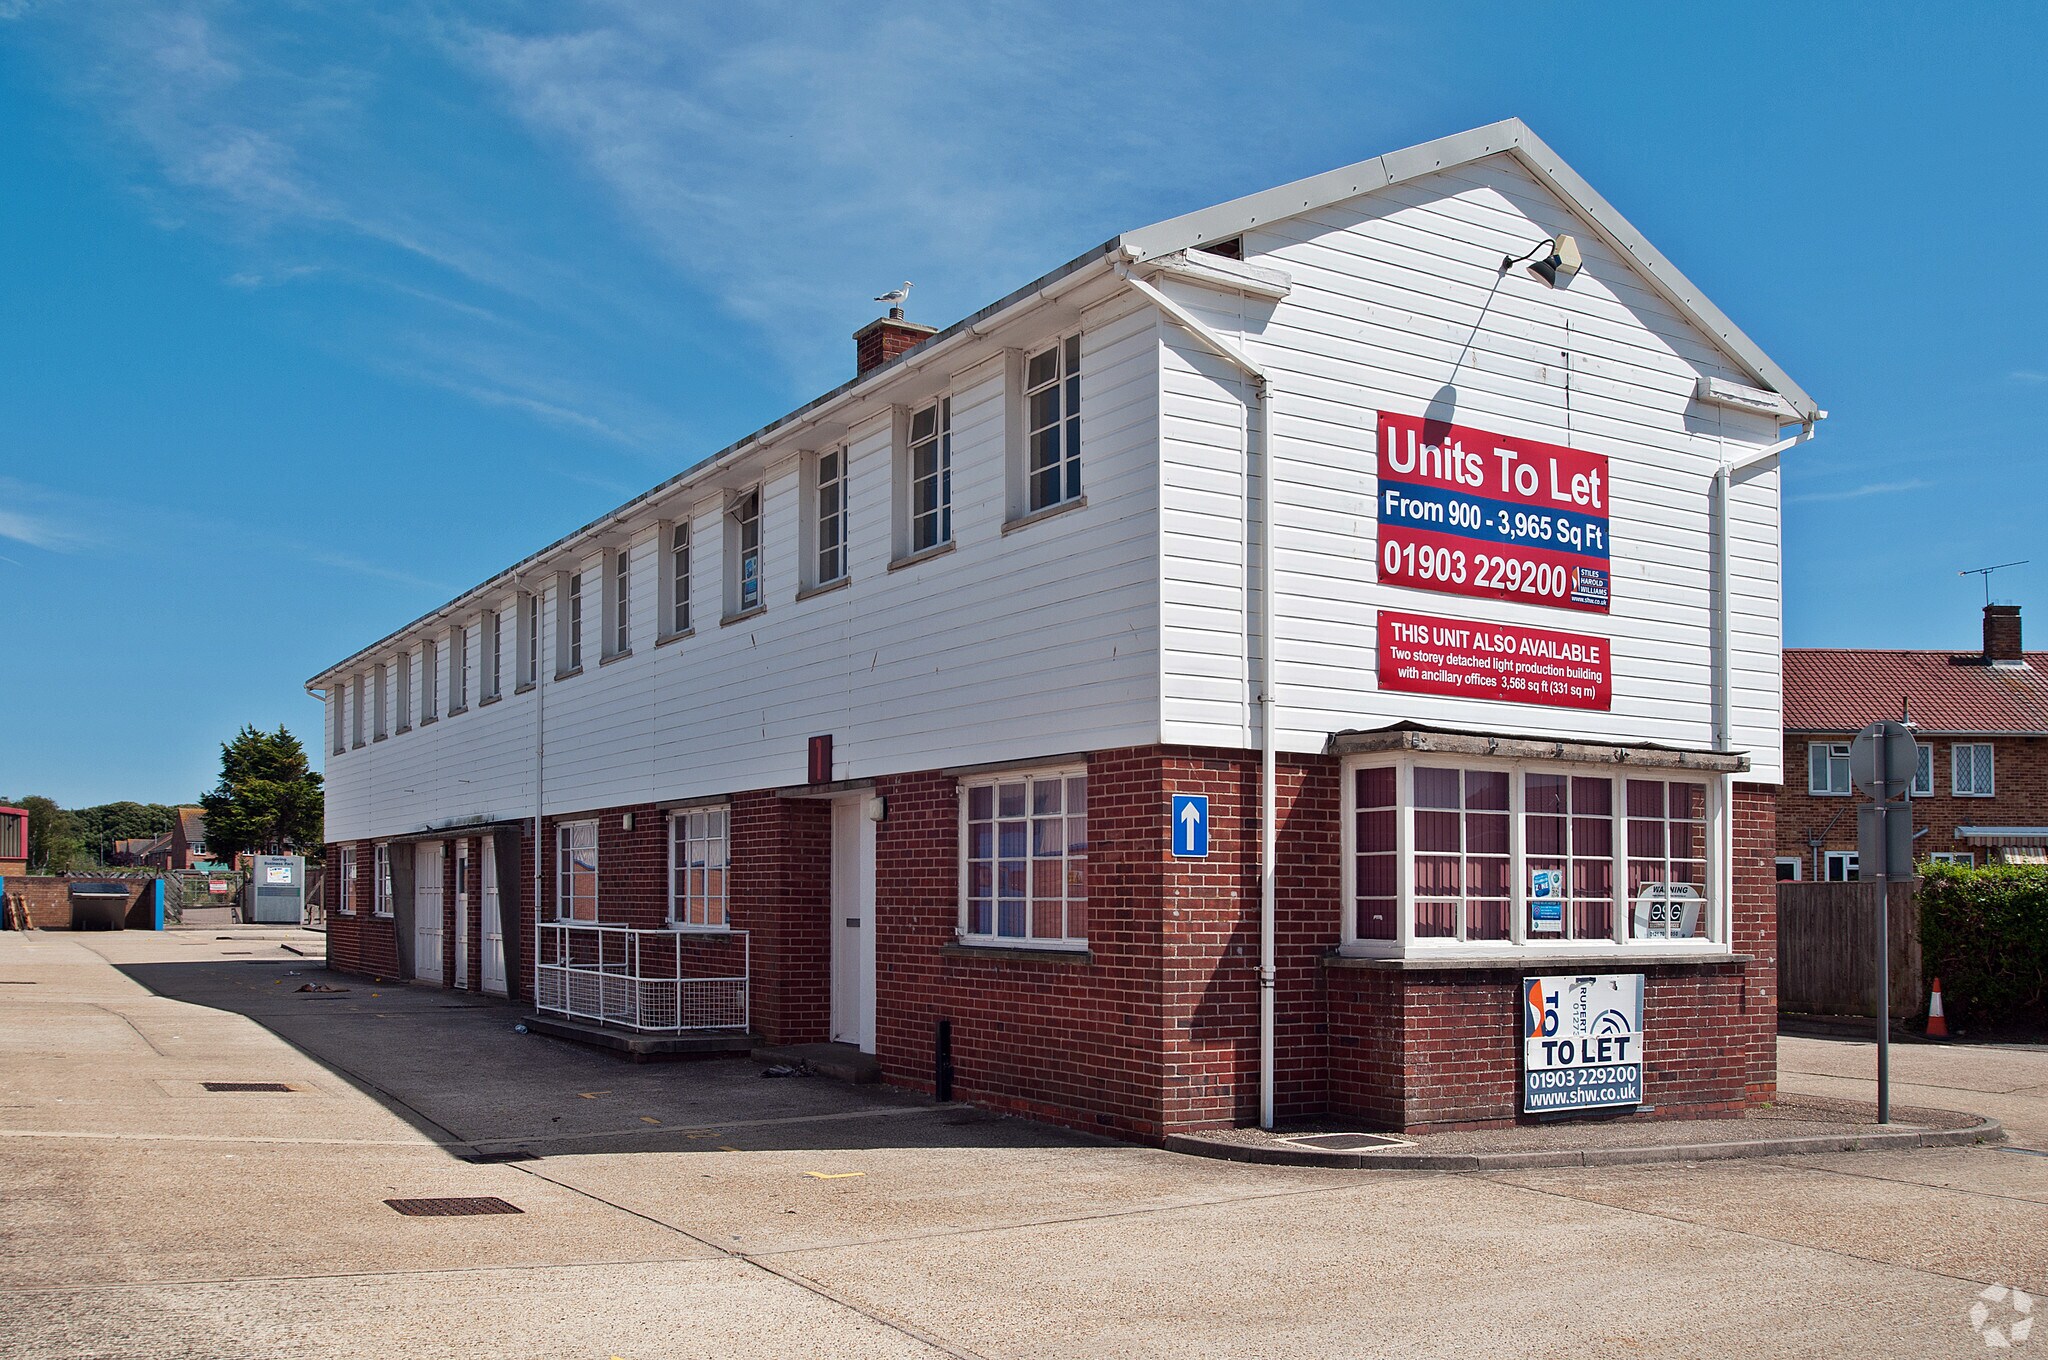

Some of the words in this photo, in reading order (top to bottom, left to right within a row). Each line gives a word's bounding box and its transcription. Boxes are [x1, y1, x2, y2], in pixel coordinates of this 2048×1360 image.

[1387, 426, 1484, 487] Units
[1493, 447, 1539, 497] To
[1549, 458, 1602, 509] Let
[1385, 490, 1444, 523] From
[1448, 500, 1481, 530] 900
[1498, 510, 1552, 540] 3,965
[1556, 518, 1582, 551] Sq
[1586, 524, 1603, 549] Ft
[1384, 540, 1467, 584] 01903
[1473, 554, 1567, 598] 229200
[1580, 569, 1599, 578] STILES
[1580, 578, 1604, 587] HAROLD
[1580, 586, 1608, 596] WILLIAMS
[1391, 622, 1429, 644] THIS
[1432, 628, 1470, 649] UNIT
[1473, 632, 1516, 654] ALSO
[1519, 638, 1600, 664] AVAILABLE
[1390, 646, 1411, 661] Two
[1413, 650, 1444, 666] storey
[1446, 653, 1491, 669] detached
[1492, 657, 1513, 673] light
[1515, 660, 1565, 677] production
[1566, 665, 1602, 683] building
[1398, 667, 1419, 679] with
[1421, 669, 1463, 686] ancillary
[1465, 674, 1497, 687] offices
[1501, 676, 1526, 691] 3,568
[1527, 682, 1540, 694] sq
[1541, 681, 1548, 693] ft
[1550, 681, 1569, 695] (331
[1570, 686, 1582, 698] sq
[1583, 686, 1596, 700] m)
[816, 738, 821, 780] 1
[1652, 886, 1689, 894] WANING
[1542, 991, 1559, 1037] TO
[1542, 1040, 1575, 1066] TO
[1582, 1037, 1631, 1064] LET
[1529, 1071, 1575, 1089] 01903
[1578, 1066, 1637, 1085] 229200
[1530, 1083, 1637, 1107] www.shw.co.uk
